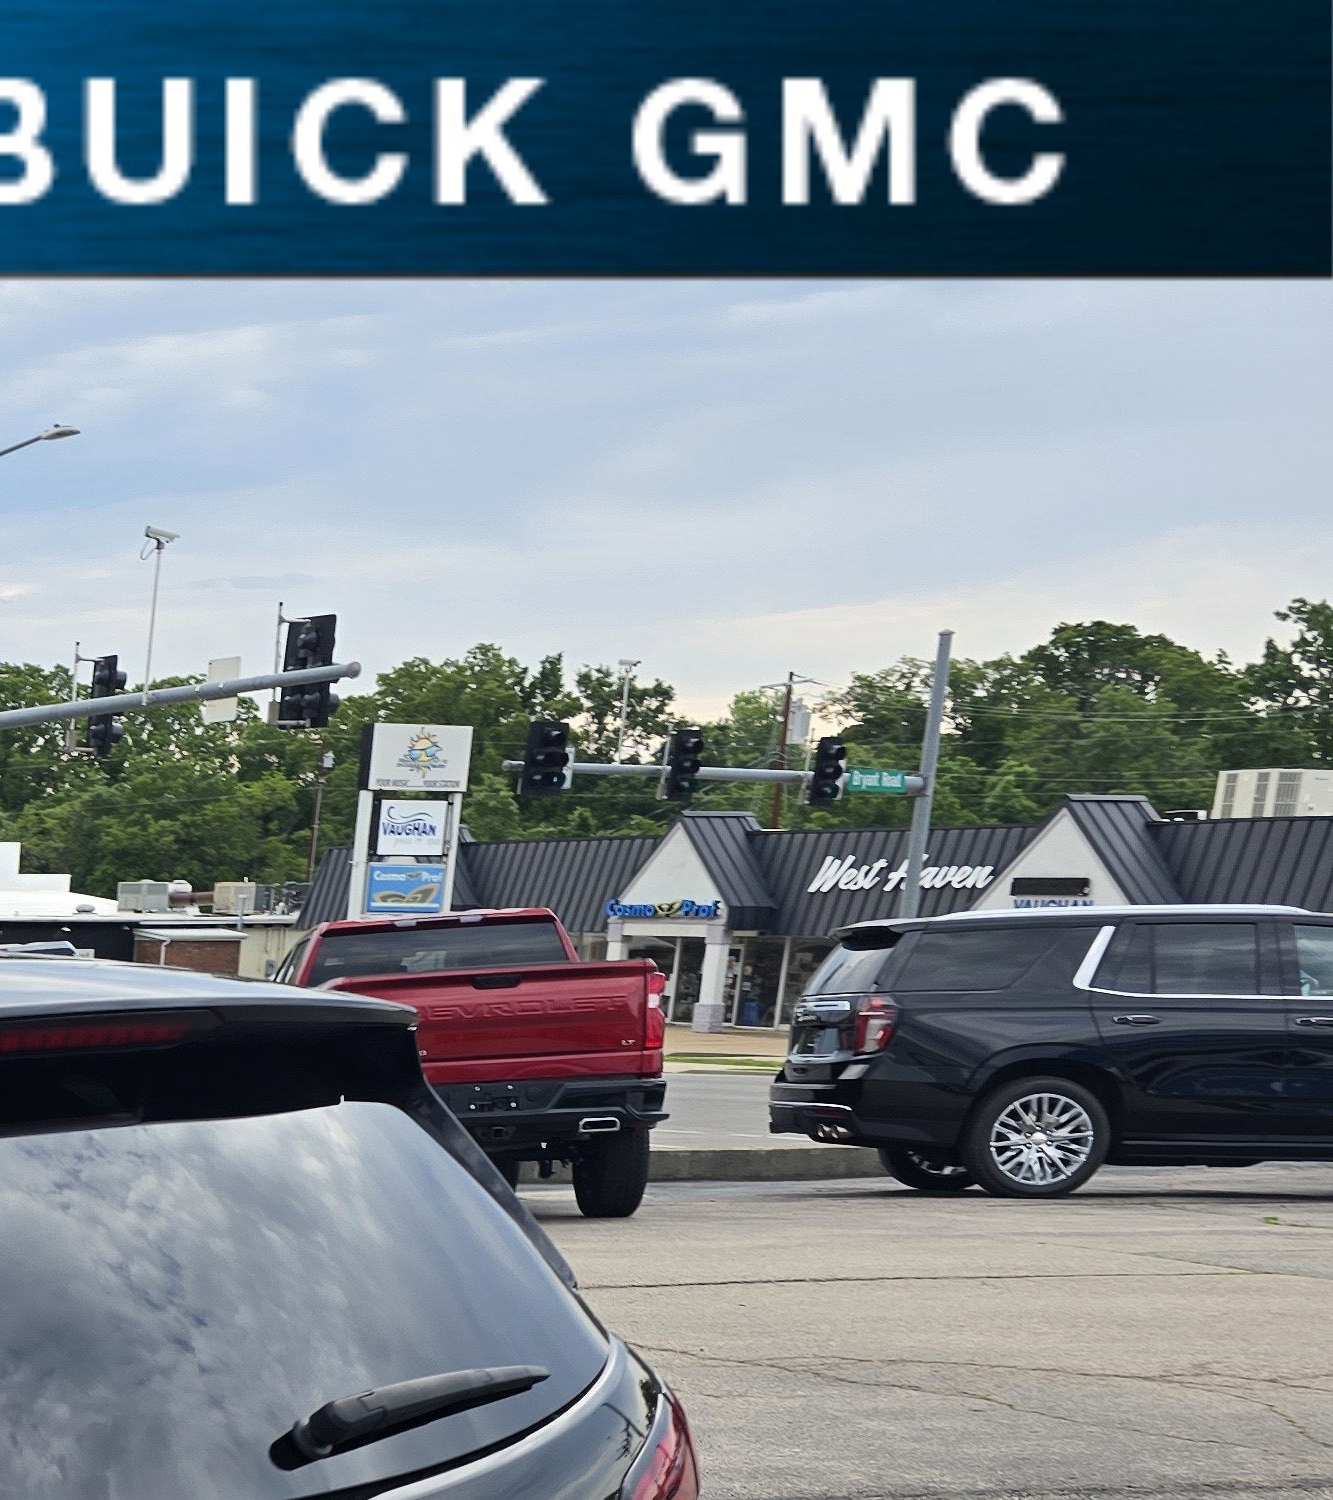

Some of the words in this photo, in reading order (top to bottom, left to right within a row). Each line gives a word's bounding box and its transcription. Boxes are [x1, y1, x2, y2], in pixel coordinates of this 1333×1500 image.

[852, 770, 880, 790] Bryant
[881, 771, 903, 788] Road
[381, 821, 437, 837] VAUGHAN
[807, 854, 887, 893] West
[605, 898, 656, 917] Cosmo
[681, 899, 722, 917] Prof
